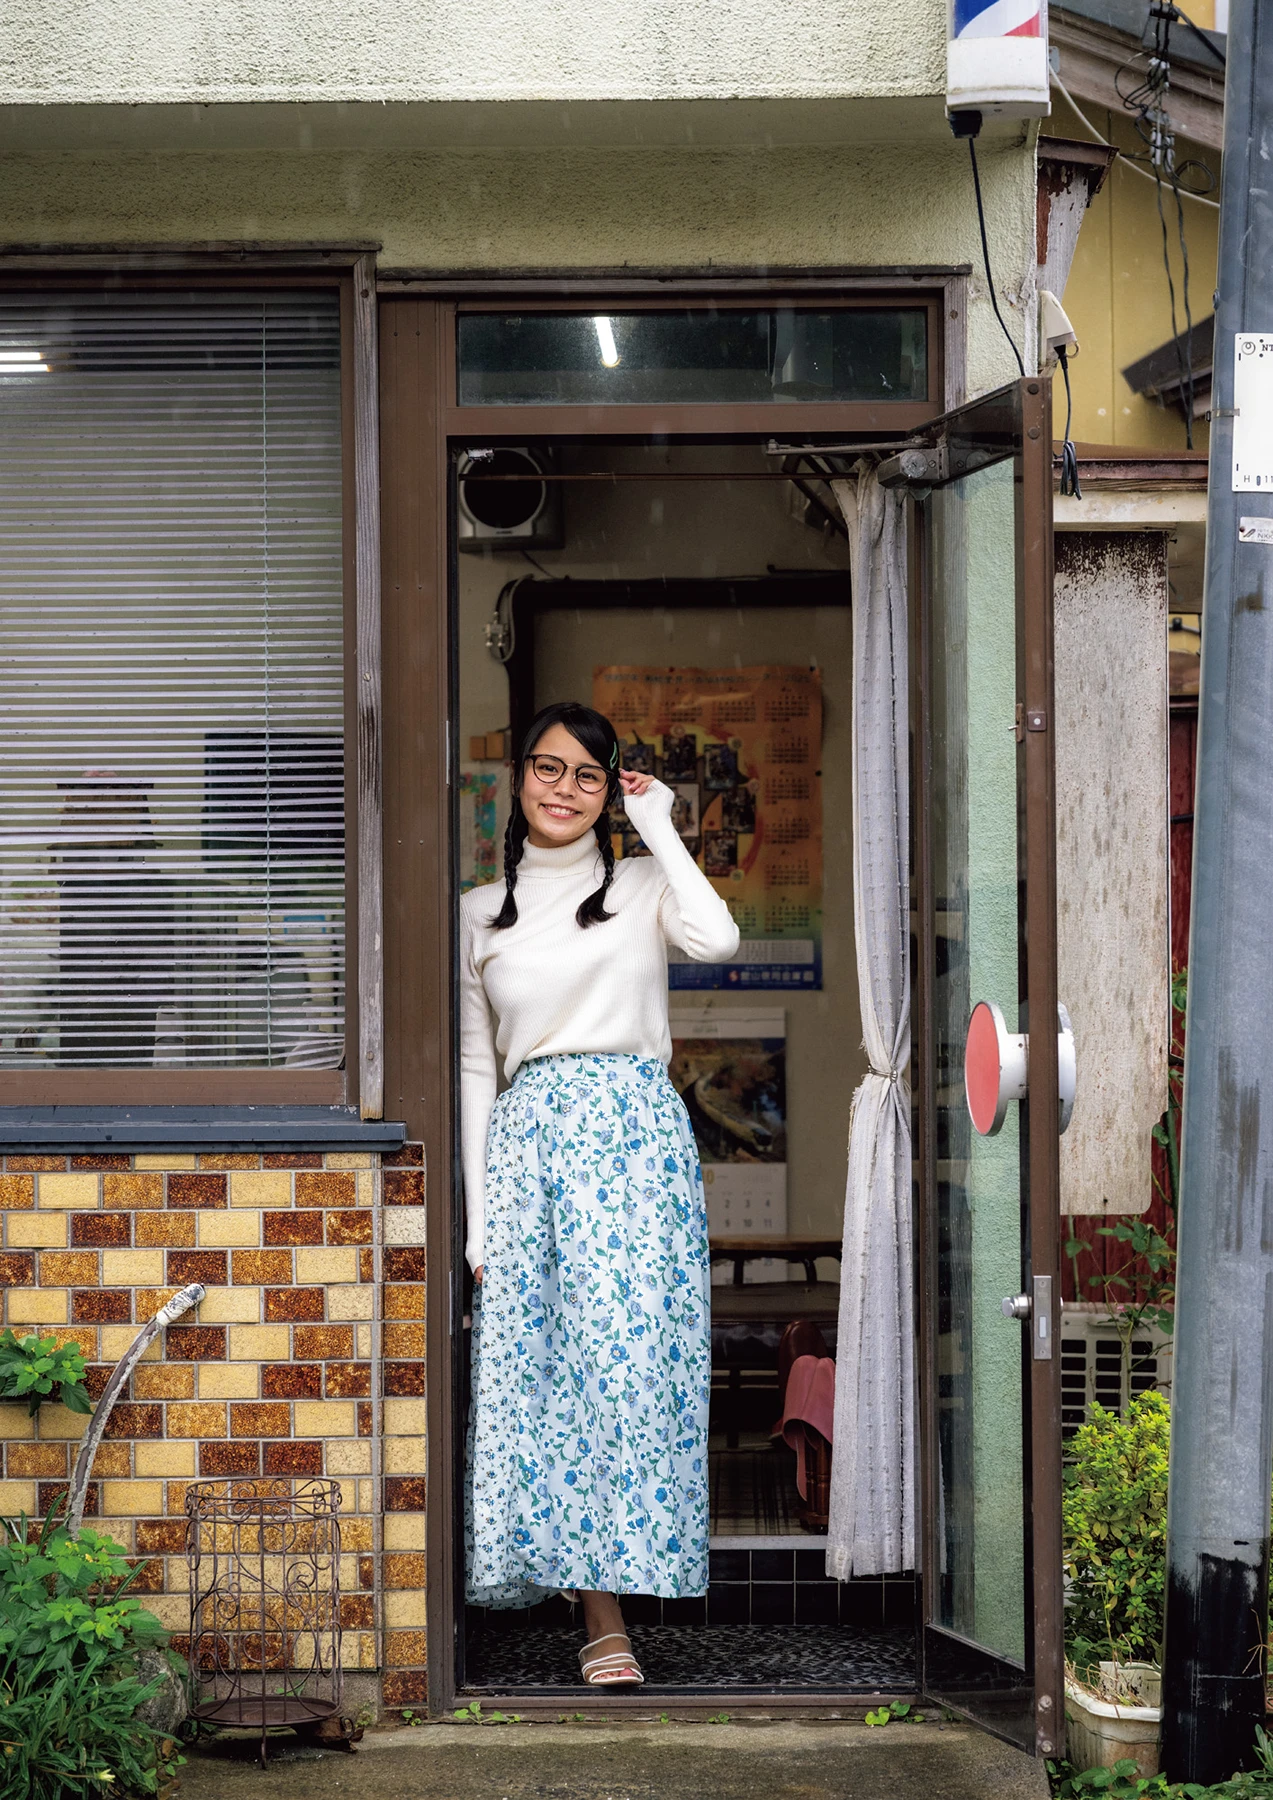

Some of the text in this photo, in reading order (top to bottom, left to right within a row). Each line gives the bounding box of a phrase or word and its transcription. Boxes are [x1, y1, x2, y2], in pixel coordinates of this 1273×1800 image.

[1243, 475, 1251, 483] H
[743, 1219, 752, 1227] 10
[763, 1218, 772, 1227] 11
